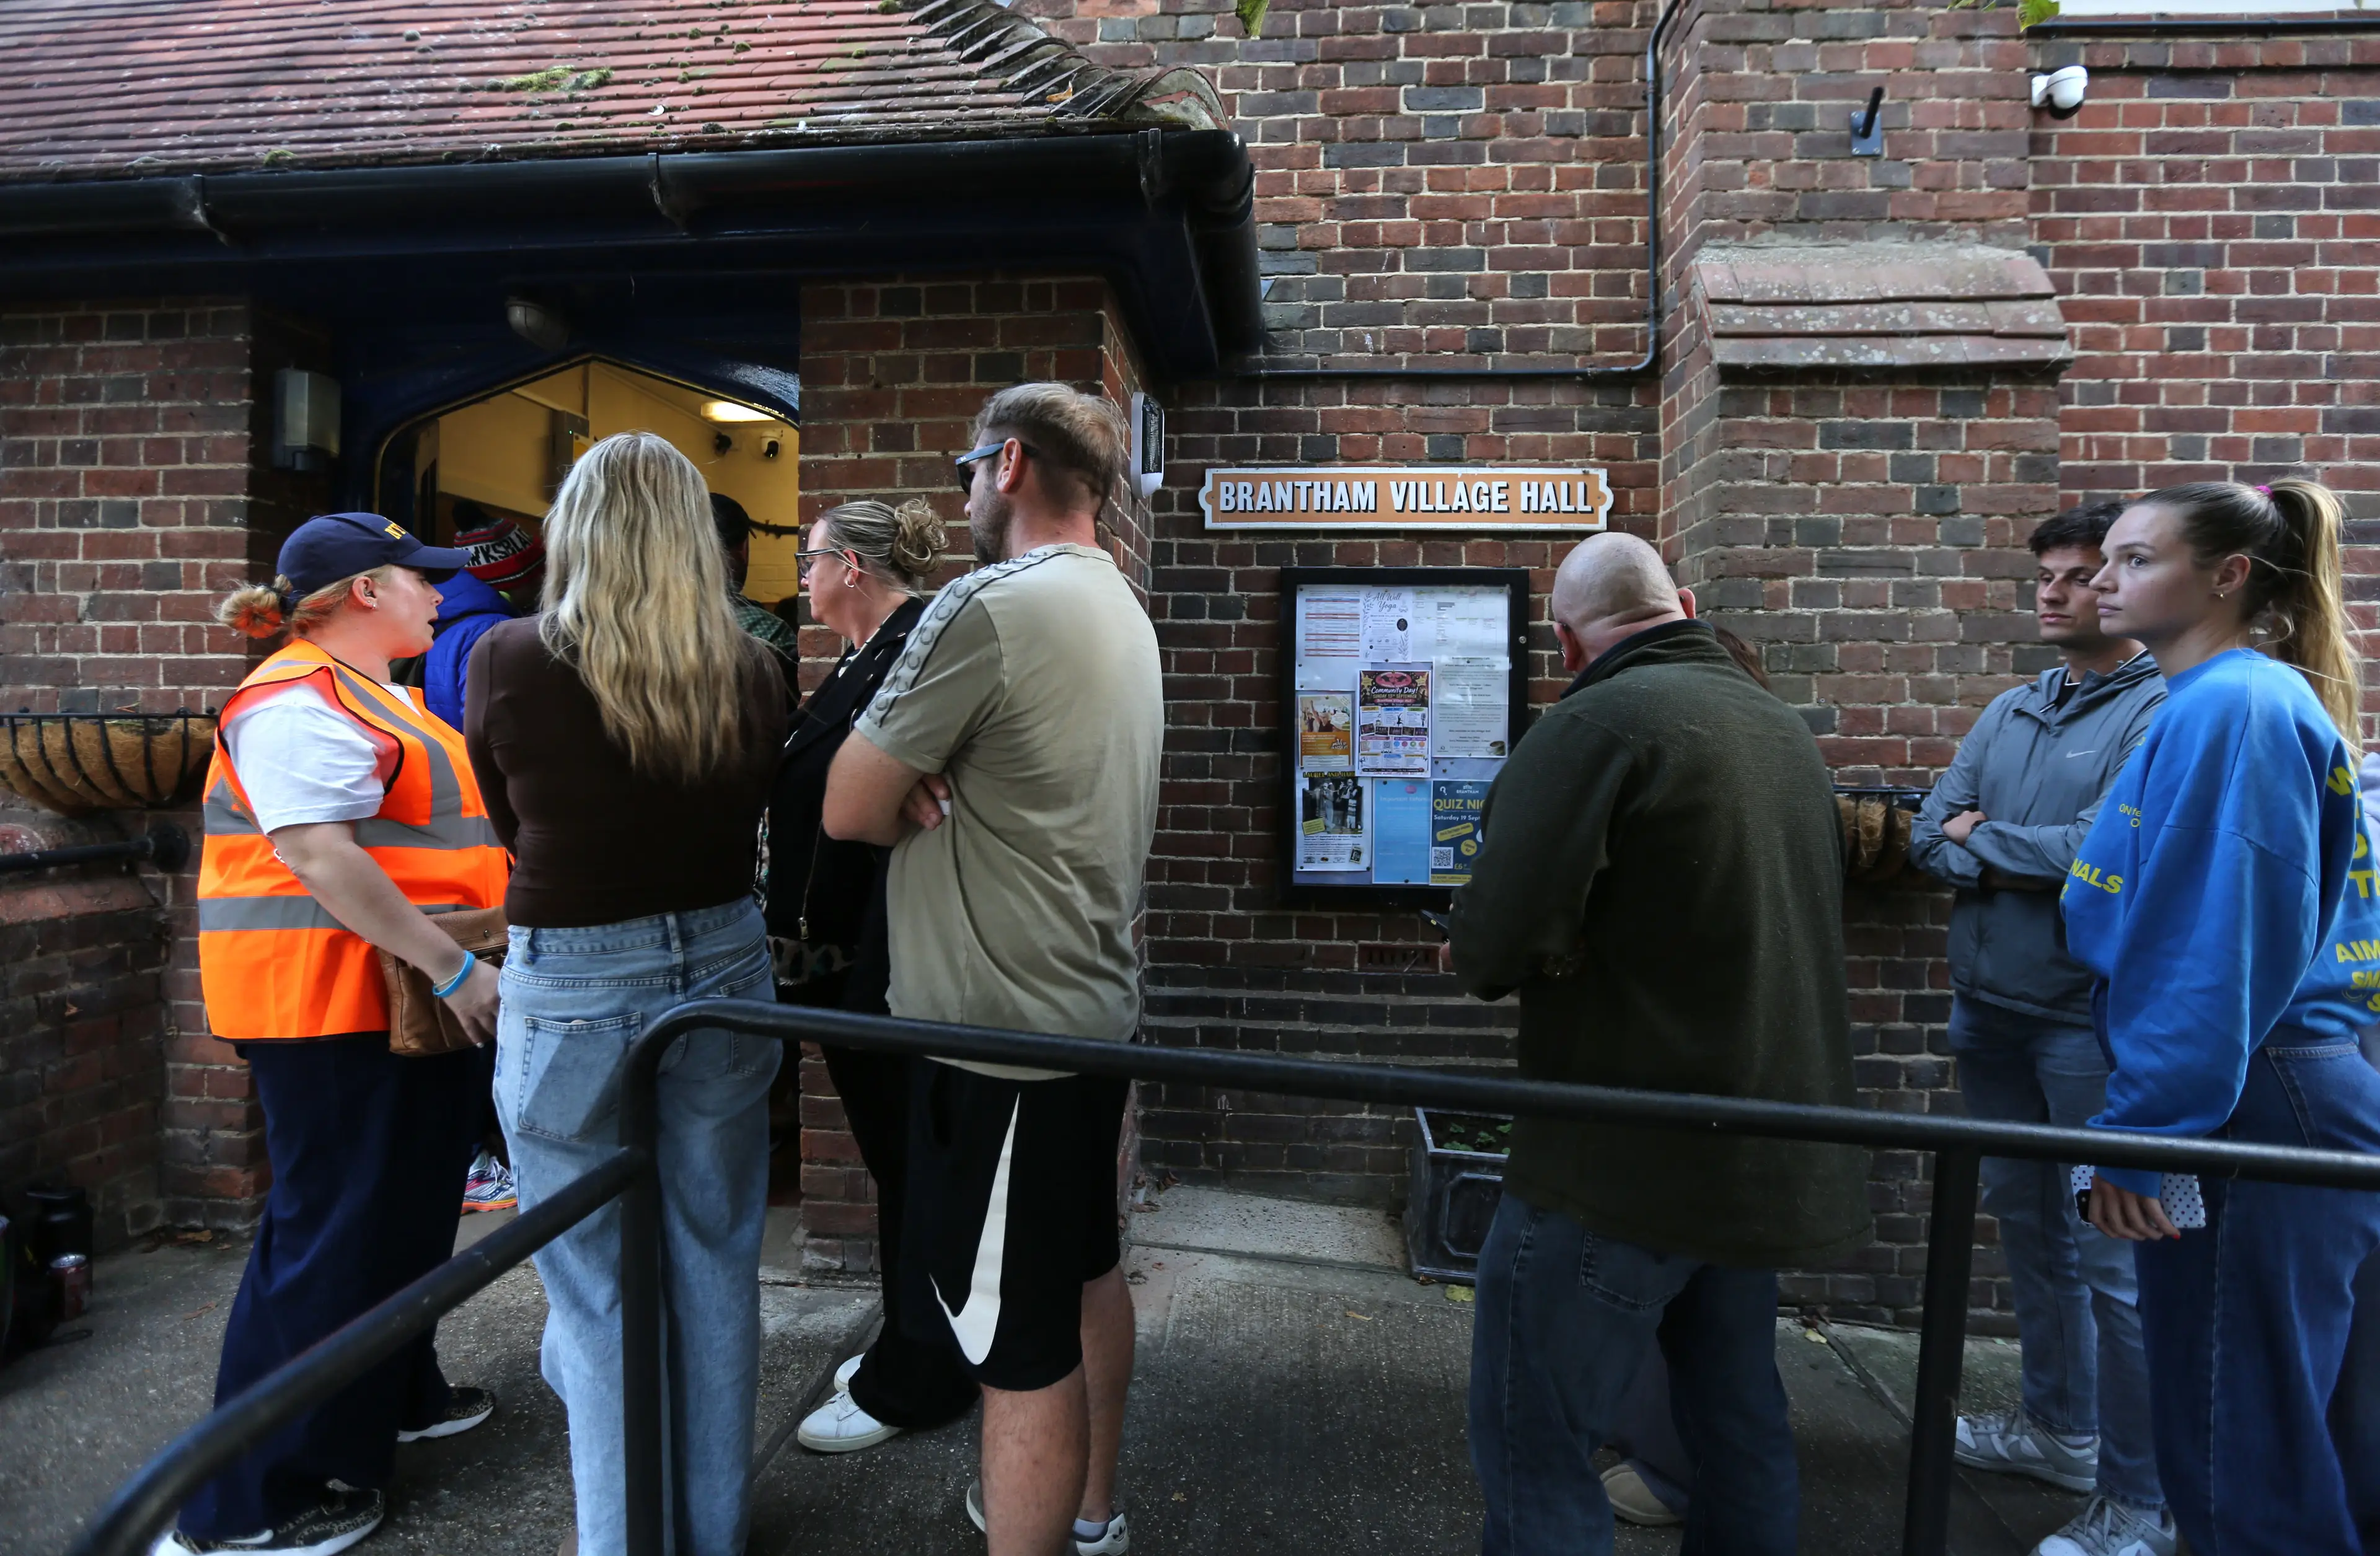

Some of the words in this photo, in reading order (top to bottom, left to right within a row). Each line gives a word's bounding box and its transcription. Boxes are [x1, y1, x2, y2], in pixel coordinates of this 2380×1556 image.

[1220, 481, 1377, 512] BRANTHAM
[1389, 481, 1509, 513] VILLAGE
[1520, 481, 1594, 514] HALL
[1373, 592, 1386, 602] All
[1386, 592, 1403, 602] Well
[1377, 600, 1398, 612] Yoga
[1371, 686, 1403, 694] Community
[1404, 686, 1419, 695] Day!
[1434, 799, 1464, 811] QUIZ
